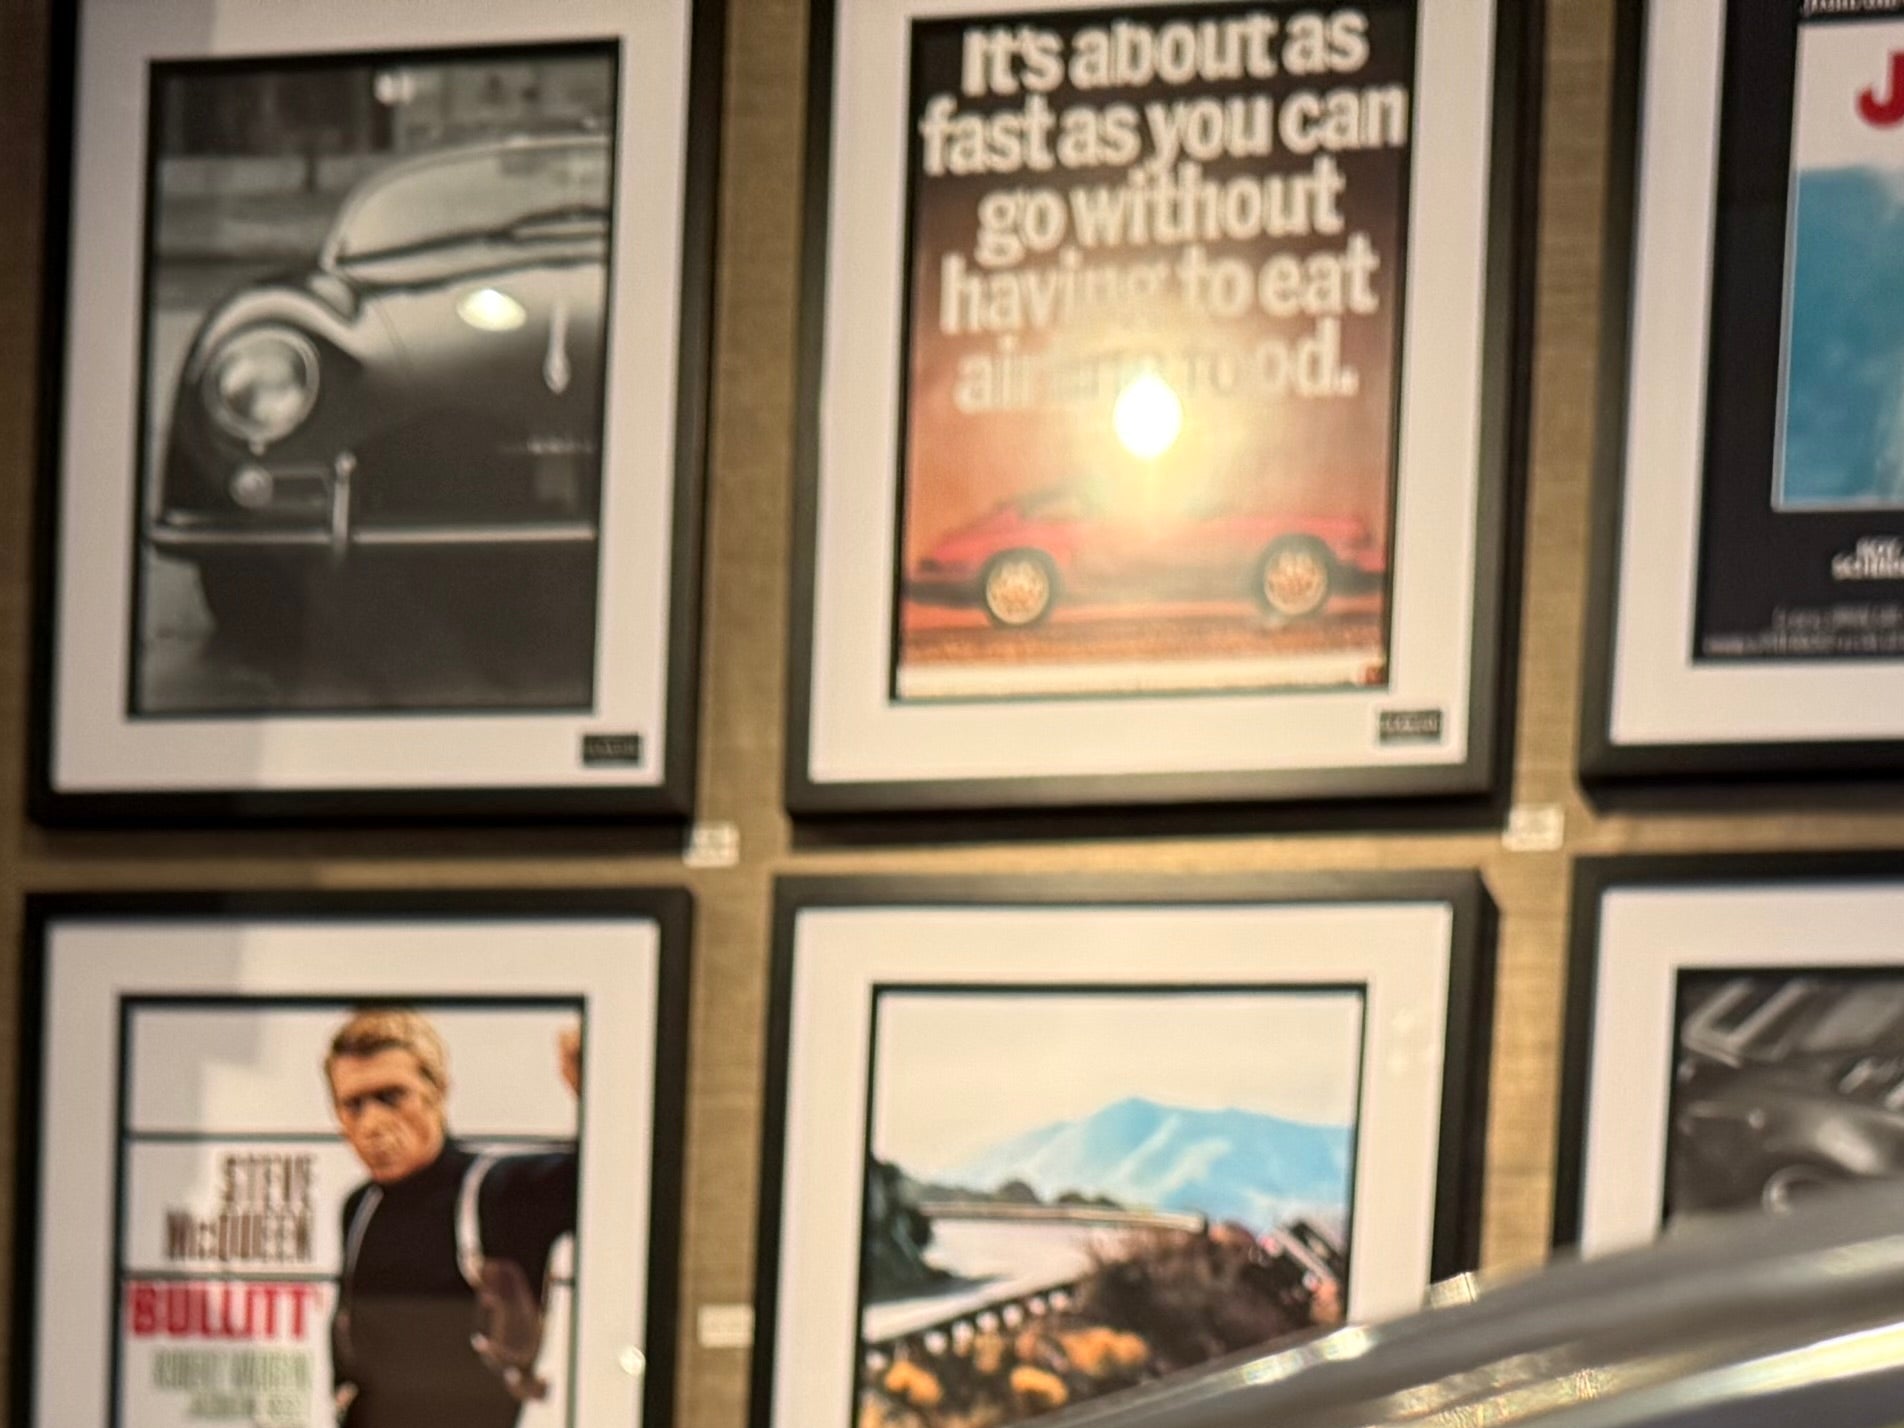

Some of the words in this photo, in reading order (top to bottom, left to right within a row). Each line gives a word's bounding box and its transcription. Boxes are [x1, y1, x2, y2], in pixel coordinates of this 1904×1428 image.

[961, 24, 1062, 95] It's
[1070, 14, 1276, 87] about
[1285, 9, 1369, 74] as
[920, 95, 1055, 176] fast
[1057, 103, 1140, 173] as
[1145, 92, 1270, 172] you
[1280, 86, 1408, 155] can
[977, 187, 1070, 266] go
[1074, 157, 1345, 247] without
[1176, 245, 1254, 316] to
[1259, 232, 1380, 316] eat
